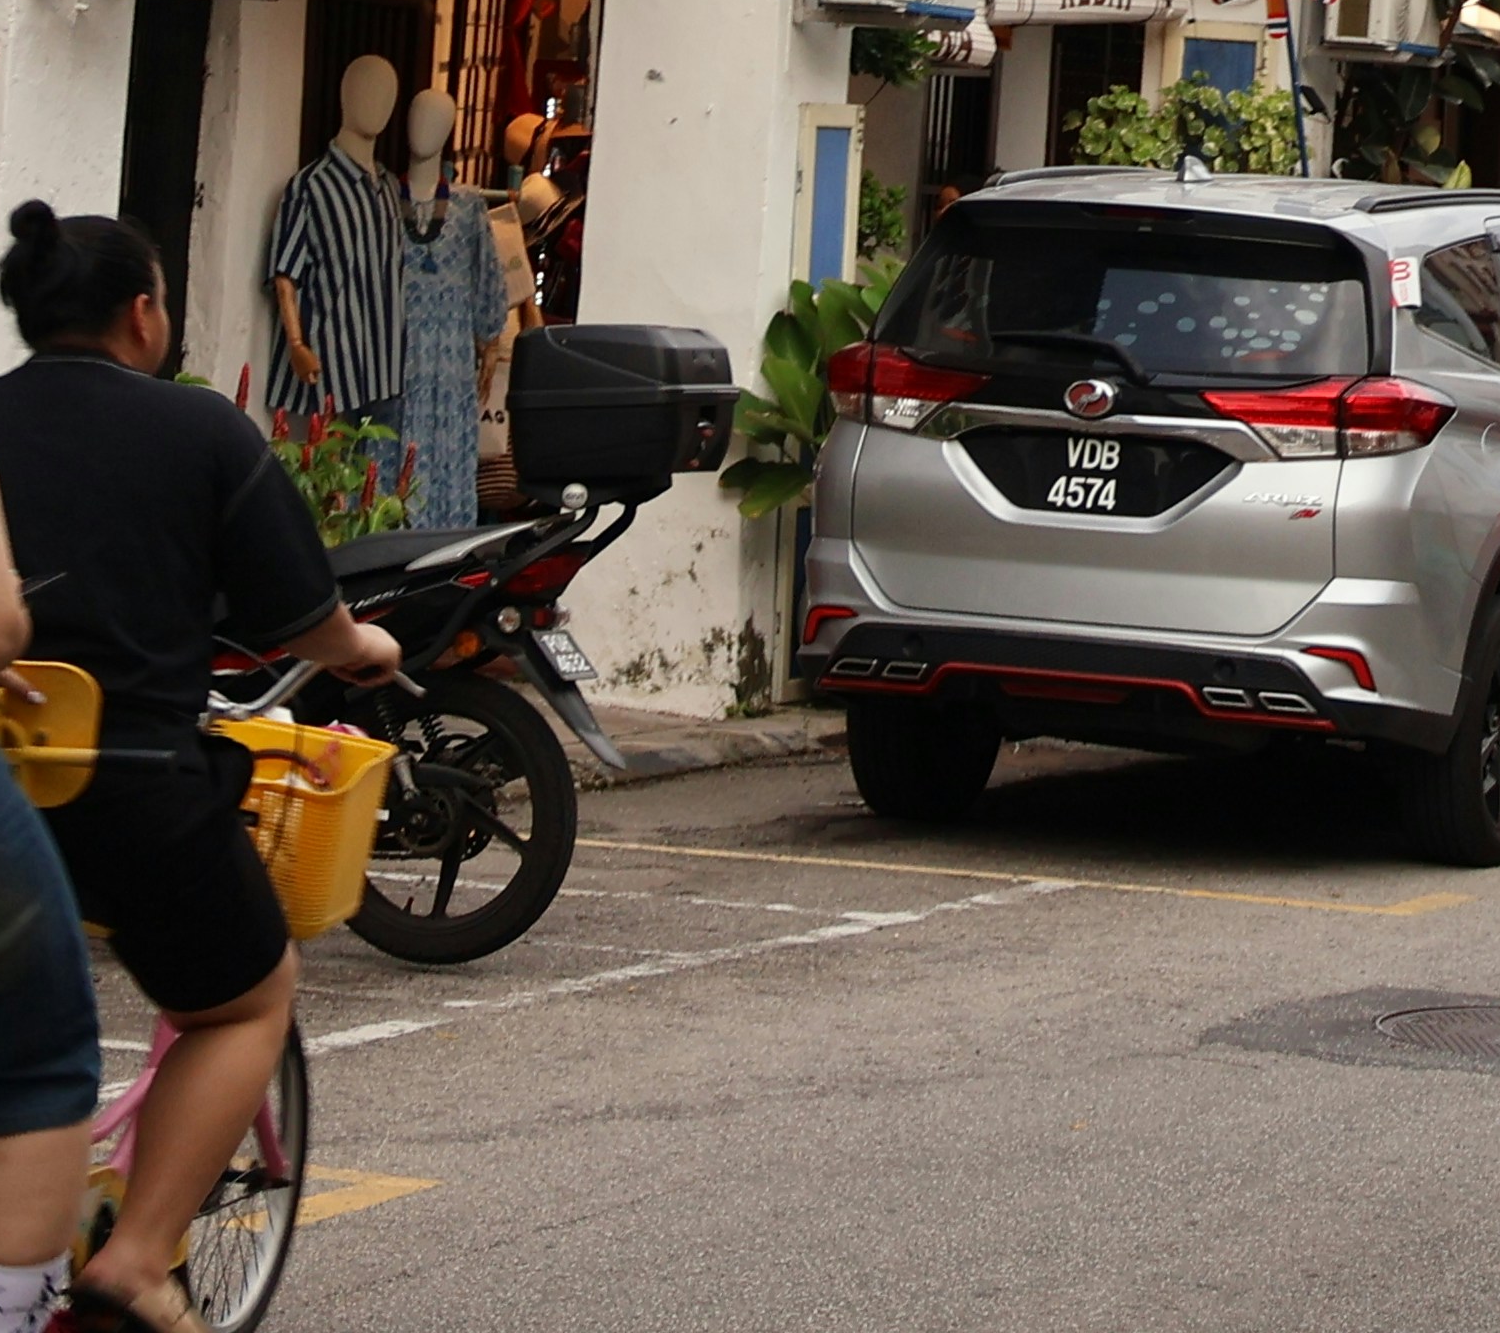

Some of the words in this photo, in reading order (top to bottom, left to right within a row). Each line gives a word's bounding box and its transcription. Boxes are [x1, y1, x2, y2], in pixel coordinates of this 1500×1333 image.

[1067, 437, 1121, 470] VDB
[1047, 476, 1117, 510] 4574
[1243, 491, 1324, 509] ARUZ
